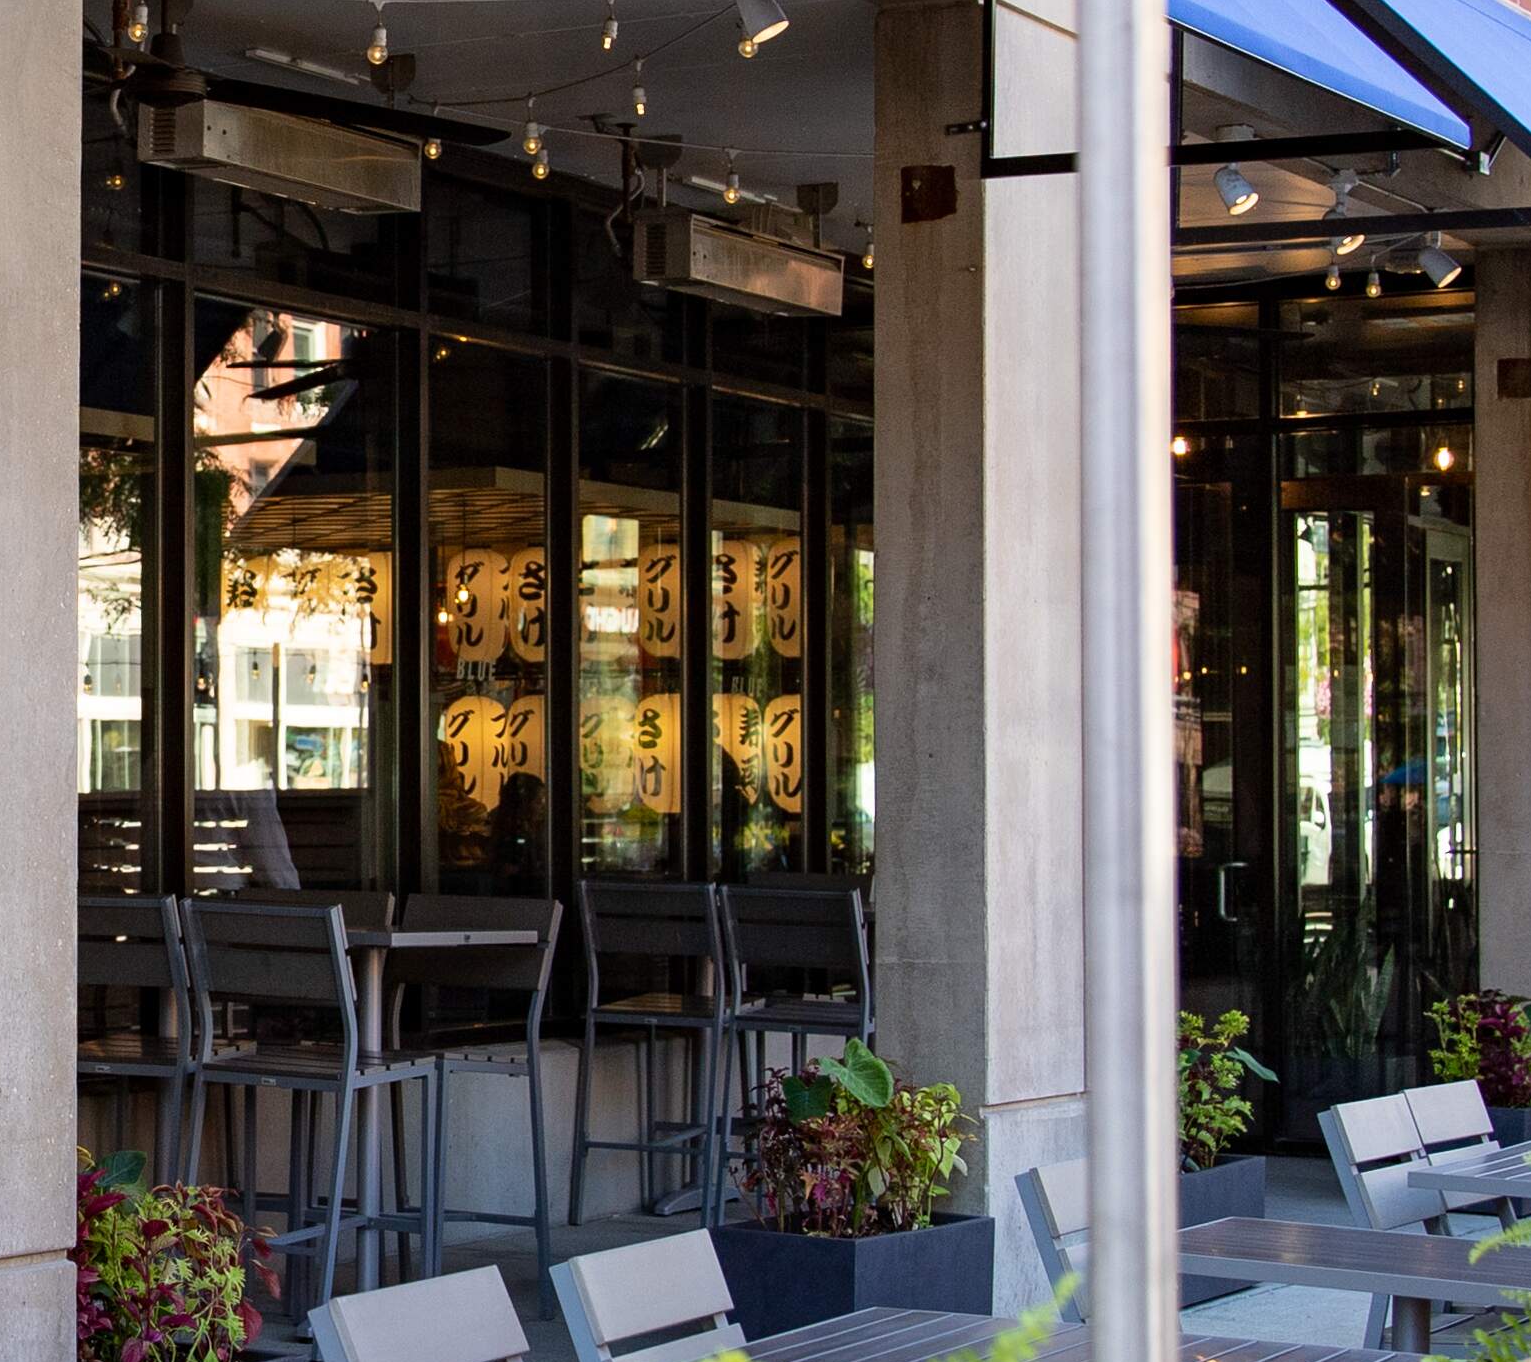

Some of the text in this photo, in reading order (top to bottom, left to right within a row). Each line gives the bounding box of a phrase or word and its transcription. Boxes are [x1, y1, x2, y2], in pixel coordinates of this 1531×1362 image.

[644, 555, 676, 643] グリル
[770, 550, 799, 640] グリル
[456, 657, 497, 681] BLUE
[638, 707, 667, 798] さけ
[769, 706, 801, 799] グリル
